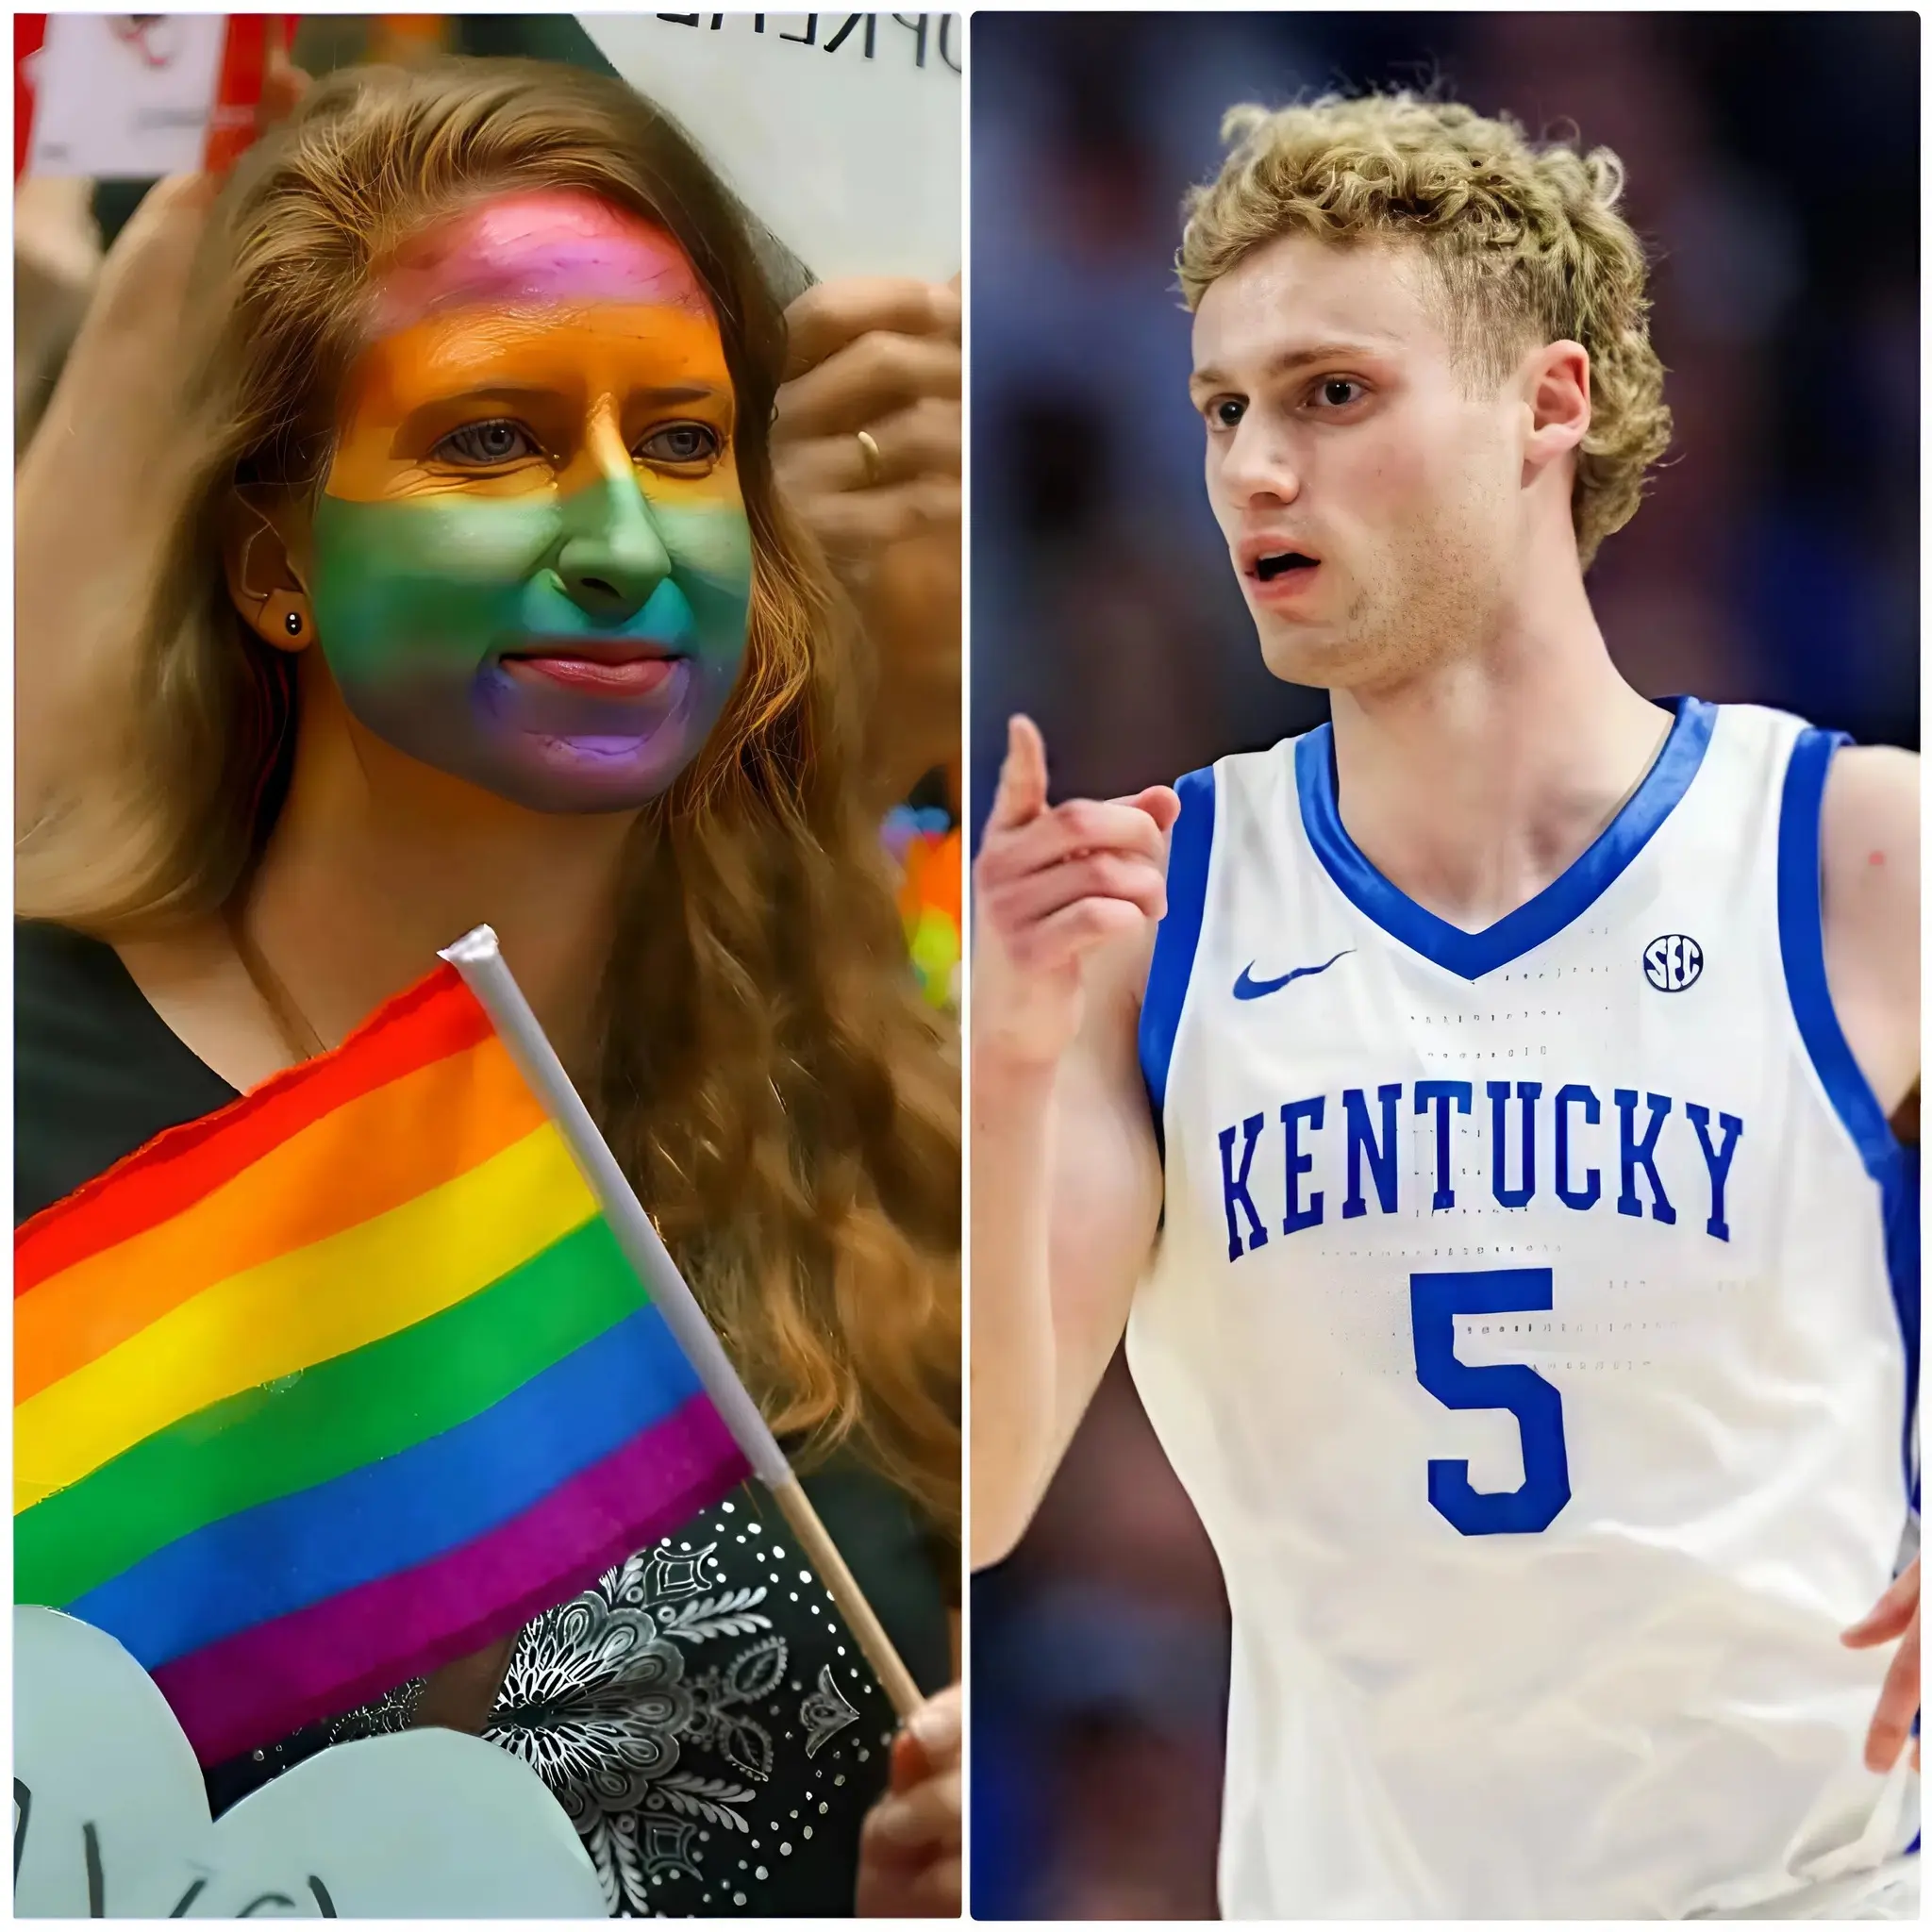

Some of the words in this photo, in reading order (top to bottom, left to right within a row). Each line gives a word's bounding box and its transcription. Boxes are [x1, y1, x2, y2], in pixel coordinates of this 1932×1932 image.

[1644, 935, 1702, 991] SEC
[1218, 1080, 1744, 1263] KENTUCKY
[1409, 1267, 1572, 1536] 5
